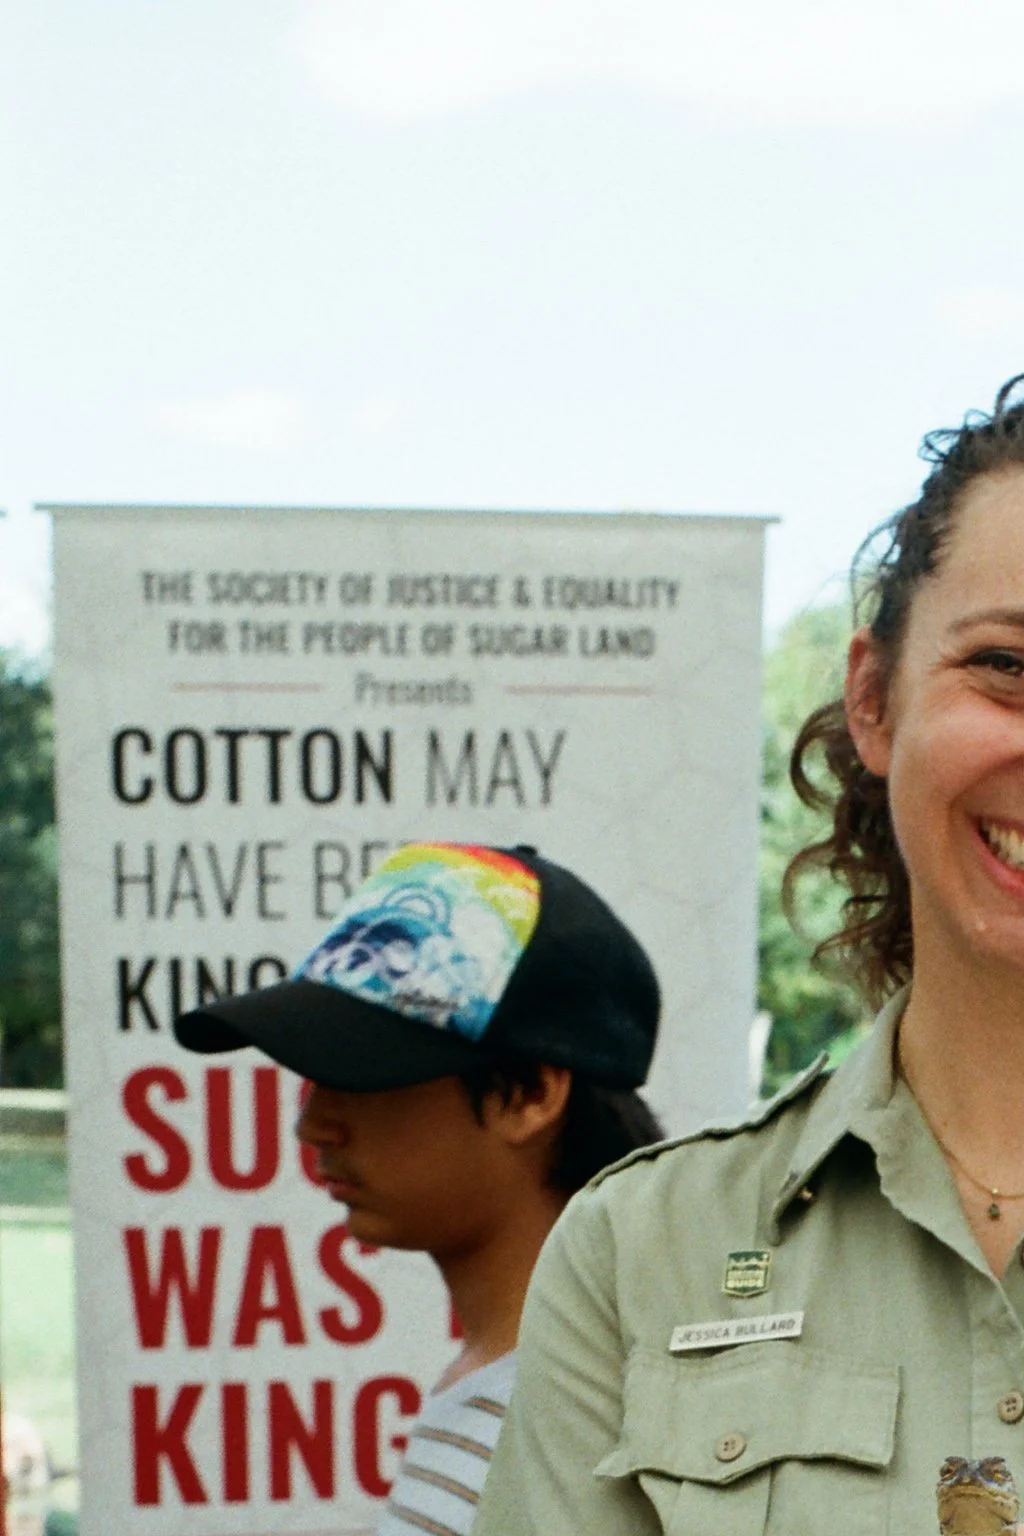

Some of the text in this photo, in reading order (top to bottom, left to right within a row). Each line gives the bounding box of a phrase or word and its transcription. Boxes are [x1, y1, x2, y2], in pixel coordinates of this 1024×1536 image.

[142, 570, 680, 610] THE SOCIETY OF JUSTICE & EQUALITY
[168, 619, 655, 660] FOR THE PEOPLE OF SUGAR LAND
[354, 671, 473, 706] Presents
[112, 728, 566, 807] COTTON MAY
[113, 840, 286, 921] HAVE
[123, 1225, 385, 1349] WAS
[678, 1318, 797, 1343] JESSICA BULLARD
[130, 1374, 422, 1507] KING
